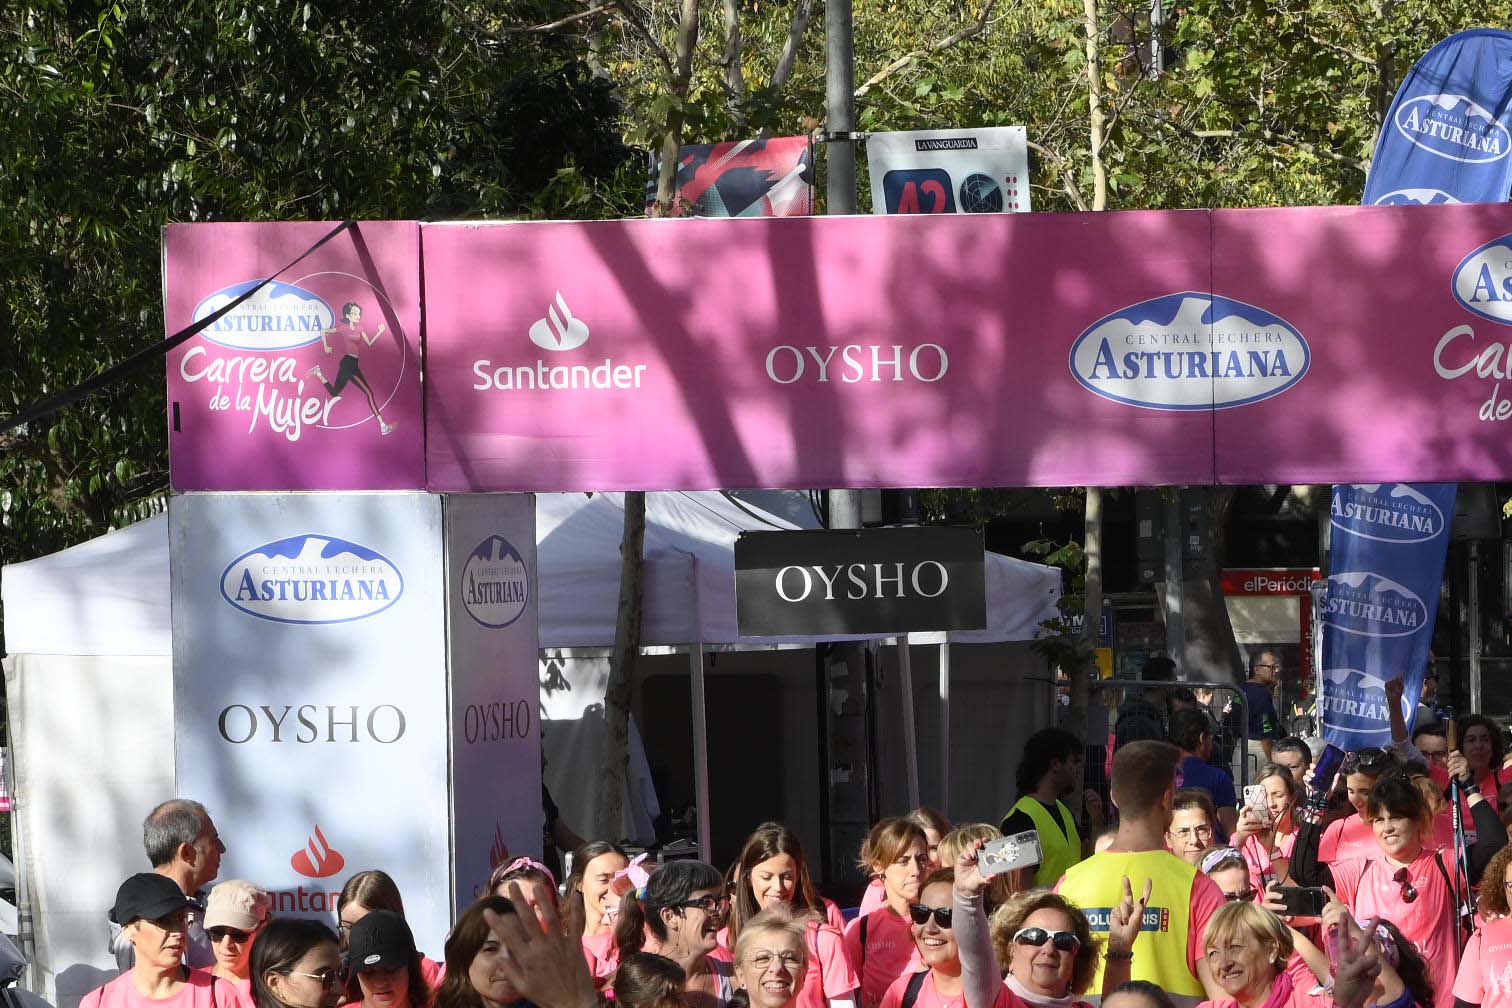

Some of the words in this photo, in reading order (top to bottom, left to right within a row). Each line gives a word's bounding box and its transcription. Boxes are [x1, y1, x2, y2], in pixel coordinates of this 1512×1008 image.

[928, 138, 977, 150] VANGUARDIA
[1402, 106, 1500, 154] ASTURIANA
[204, 306, 323, 332] ASTURIANA
[237, 303, 267, 311] NTRAL
[1125, 333, 1200, 345] CENTRAL
[1208, 332, 1283, 344] LECHERA
[181, 346, 297, 382] Carrera
[473, 359, 647, 391] Santander
[765, 343, 949, 384] OYSHO
[1089, 336, 1291, 380] ASTURIANA
[210, 385, 231, 410] de
[235, 384, 251, 410] la
[249, 381, 341, 441] Mujer
[1479, 383, 1512, 421] de
[1331, 491, 1434, 534] ASTURIANA
[235, 567, 391, 601] ASTURIANA
[262, 566, 321, 575] CENTRAL
[325, 565, 385, 575] LECHERA
[466, 569, 526, 605] ASTURIANA
[775, 560, 949, 603] OYSHO
[218, 704, 407, 744] OYSHO
[464, 699, 530, 745] OYSHO
[1087, 912, 1159, 926] OLURIS
